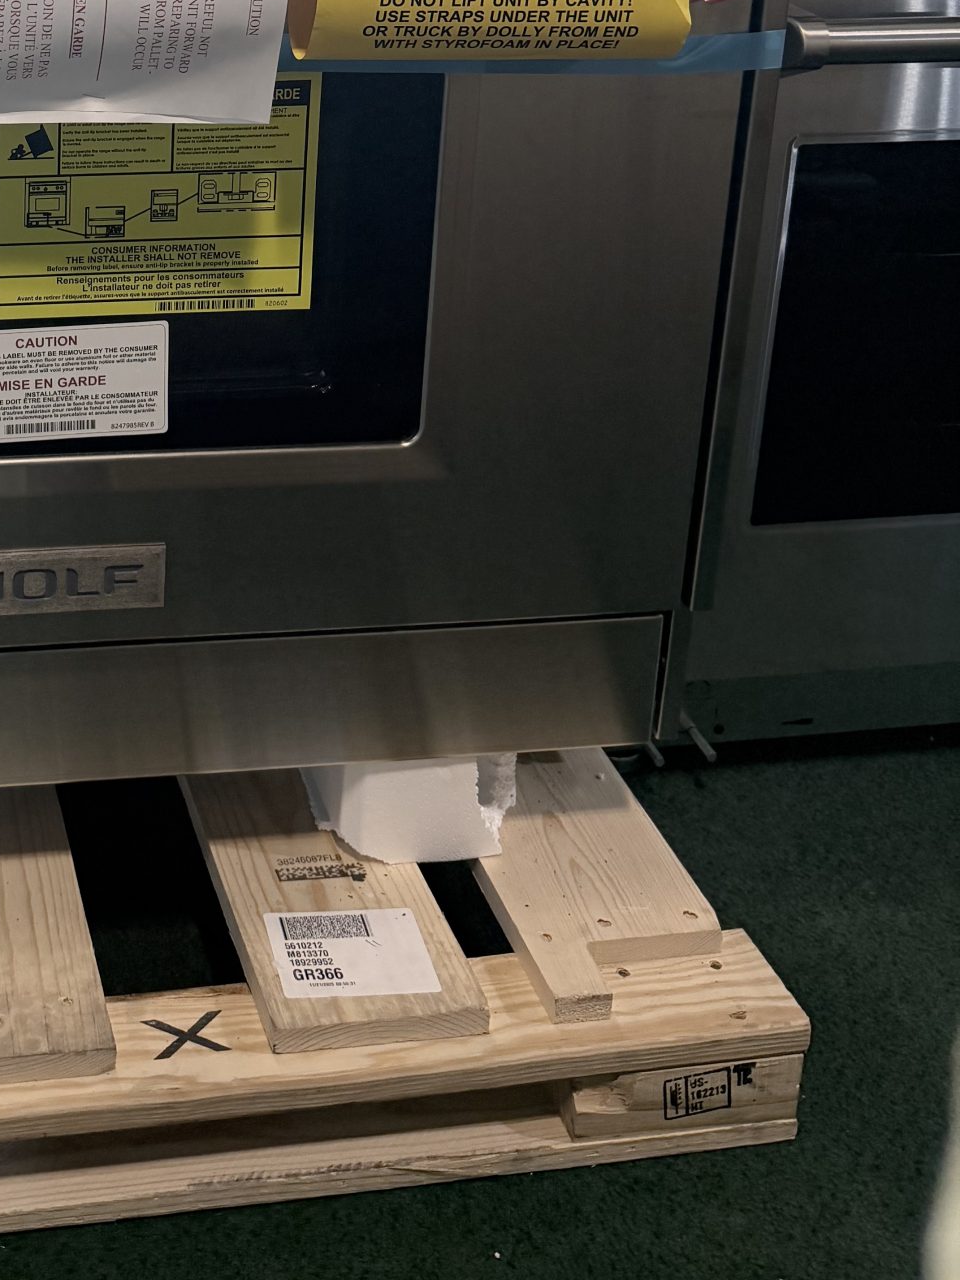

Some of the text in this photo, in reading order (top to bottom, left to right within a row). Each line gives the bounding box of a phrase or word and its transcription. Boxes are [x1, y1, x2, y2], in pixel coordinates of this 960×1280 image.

[137, 4, 151, 33] WILL
[376, 10, 634, 23] USE STRAPS UNDER THE UNIT
[24, 3, 38, 51] L'UNITÉ
[41, 24, 53, 40] DE
[363, 25, 639, 37] OR TRUCK BY DOLLY FROM END
[72, 17, 85, 57] GARDE
[374, 39, 620, 49] WITH STYROFOAM IN PLACE!
[40, 43, 51, 58] NE
[131, 33, 147, 71] OCCUR
[178, 22, 197, 74] FORWARD
[198, 36, 210, 56] NOT
[6, 50, 19, 81] VOUS
[22, 54, 34, 79] VERS
[38, 60, 50, 77] PAS
[164, 58, 174, 69] TO
[273, 88, 301, 100] RDE
[91, 243, 216, 255] CONSUMER INFORMATION
[65, 251, 241, 264] THE INSTALLER SHALL NOT REMOVE
[56, 275, 131, 285] Renseignements
[134, 275, 155, 283] pour
[172, 272, 244, 281] consommateurs
[82, 282, 140, 292] L'installateur
[155, 282, 173, 290] doit
[175, 282, 191, 290] pas
[194, 280, 221, 288] retirer
[15, 335, 77, 349] CAUTION
[119, 345, 158, 353] CONSUMER
[35, 378, 53, 389] EN
[57, 375, 106, 388] GARDE
[23, 396, 41, 404] ÊTRE
[42, 394, 73, 403] ENLEVÉE
[101, 390, 158, 399] CONSOMMATEUR
[25, 389, 77, 398] INSTALLATEUR:
[284, 941, 323, 950] 5610212
[286, 949, 329, 958] M813370
[290, 957, 334, 966] 18929952
[292, 967, 344, 981] GR366
